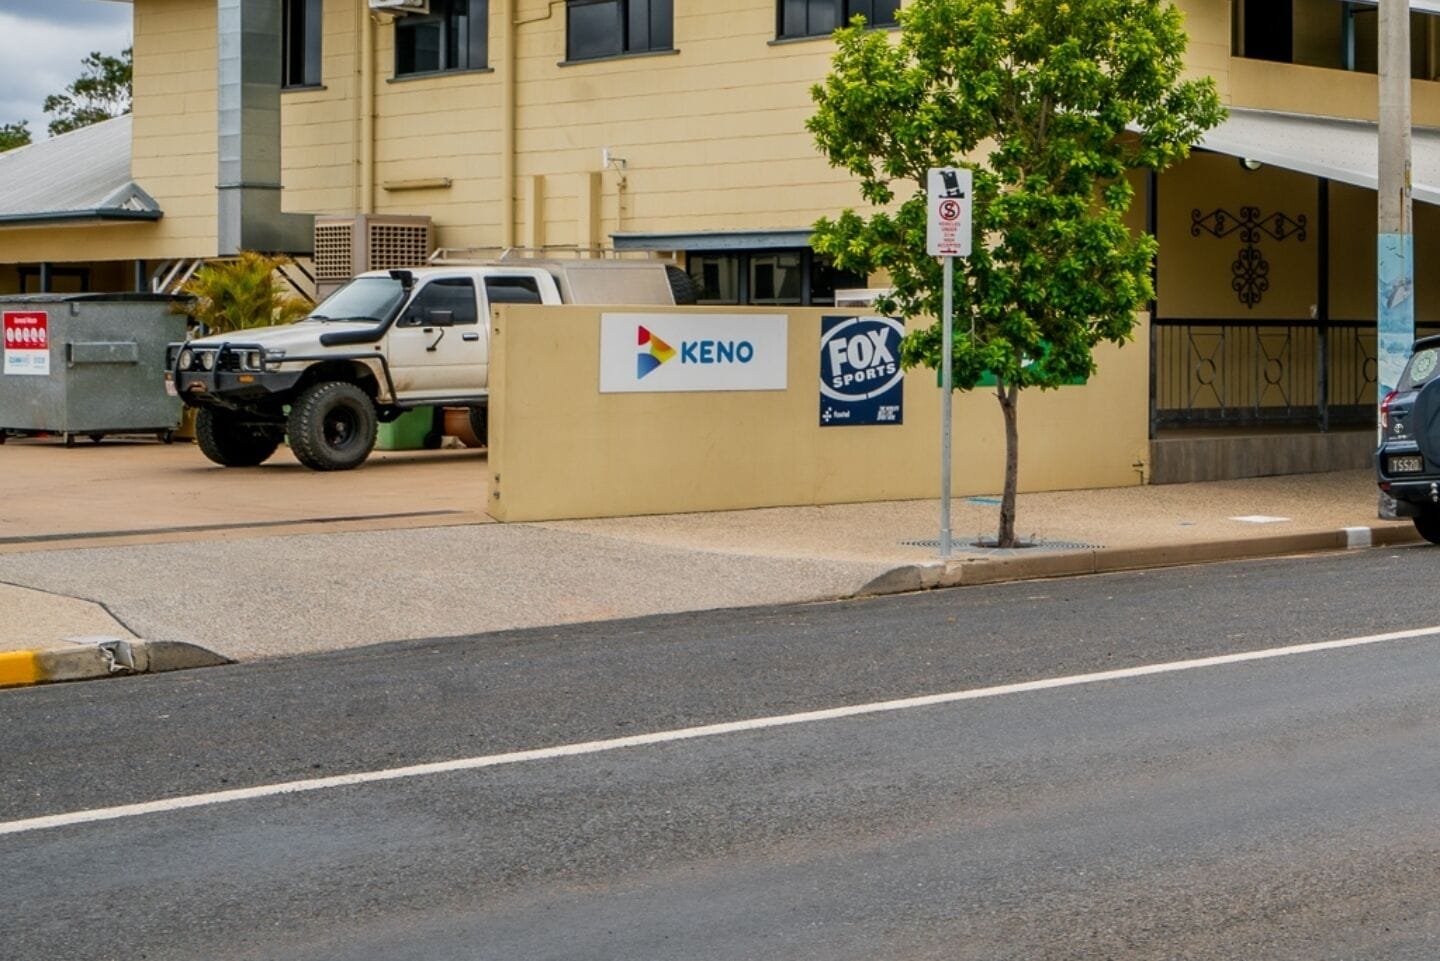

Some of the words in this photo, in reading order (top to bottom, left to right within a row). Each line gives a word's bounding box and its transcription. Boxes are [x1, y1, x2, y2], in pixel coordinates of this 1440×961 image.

[681, 340, 754, 364] KENO
[828, 326, 895, 377] FOX
[832, 363, 896, 388] SPORTS
